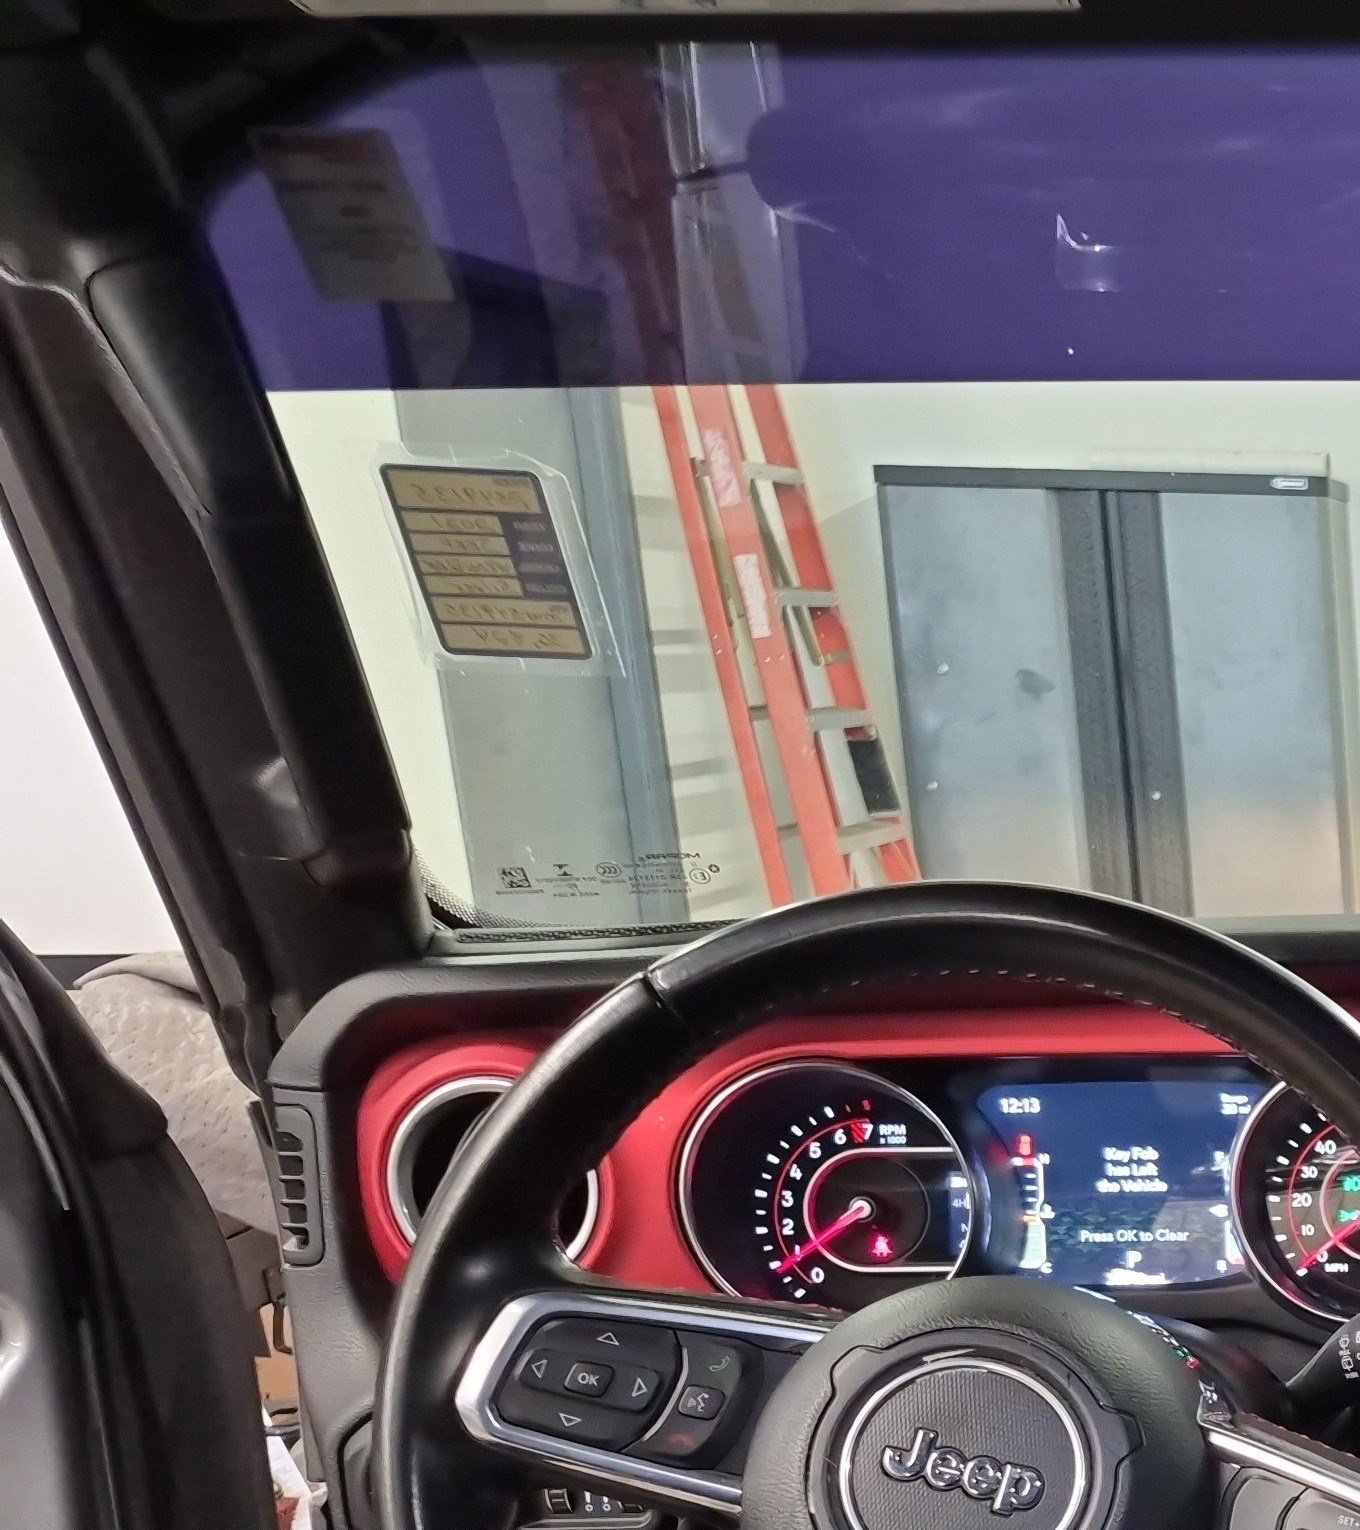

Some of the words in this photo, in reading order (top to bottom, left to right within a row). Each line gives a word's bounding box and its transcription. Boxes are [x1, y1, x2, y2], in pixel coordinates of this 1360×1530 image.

[1000, 1097, 1040, 1113] 12:13
[834, 1129, 847, 1144] 6
[862, 1124, 873, 1139] 7
[879, 1123, 906, 1136] RPM
[809, 1143, 822, 1159] 5
[1103, 1147, 1130, 1162] Key
[1314, 1140, 1337, 1154] 40
[790, 1164, 802, 1179] 4
[1301, 1166, 1318, 1179] 30
[781, 1191, 794, 1206] 3
[1292, 1193, 1312, 1207] 20
[782, 1219, 794, 1235] 2
[1301, 1224, 1314, 1236] 10
[1080, 1230, 1114, 1242] Press
[1116, 1229, 1138, 1242] OK
[1139, 1230, 1154, 1242] to
[1155, 1229, 1189, 1242] Clear
[811, 1267, 824, 1283] 0
[1324, 1263, 1349, 1273] MPH
[576, 1372, 600, 1387] OK
[882, 1427, 1046, 1518] Jeep
